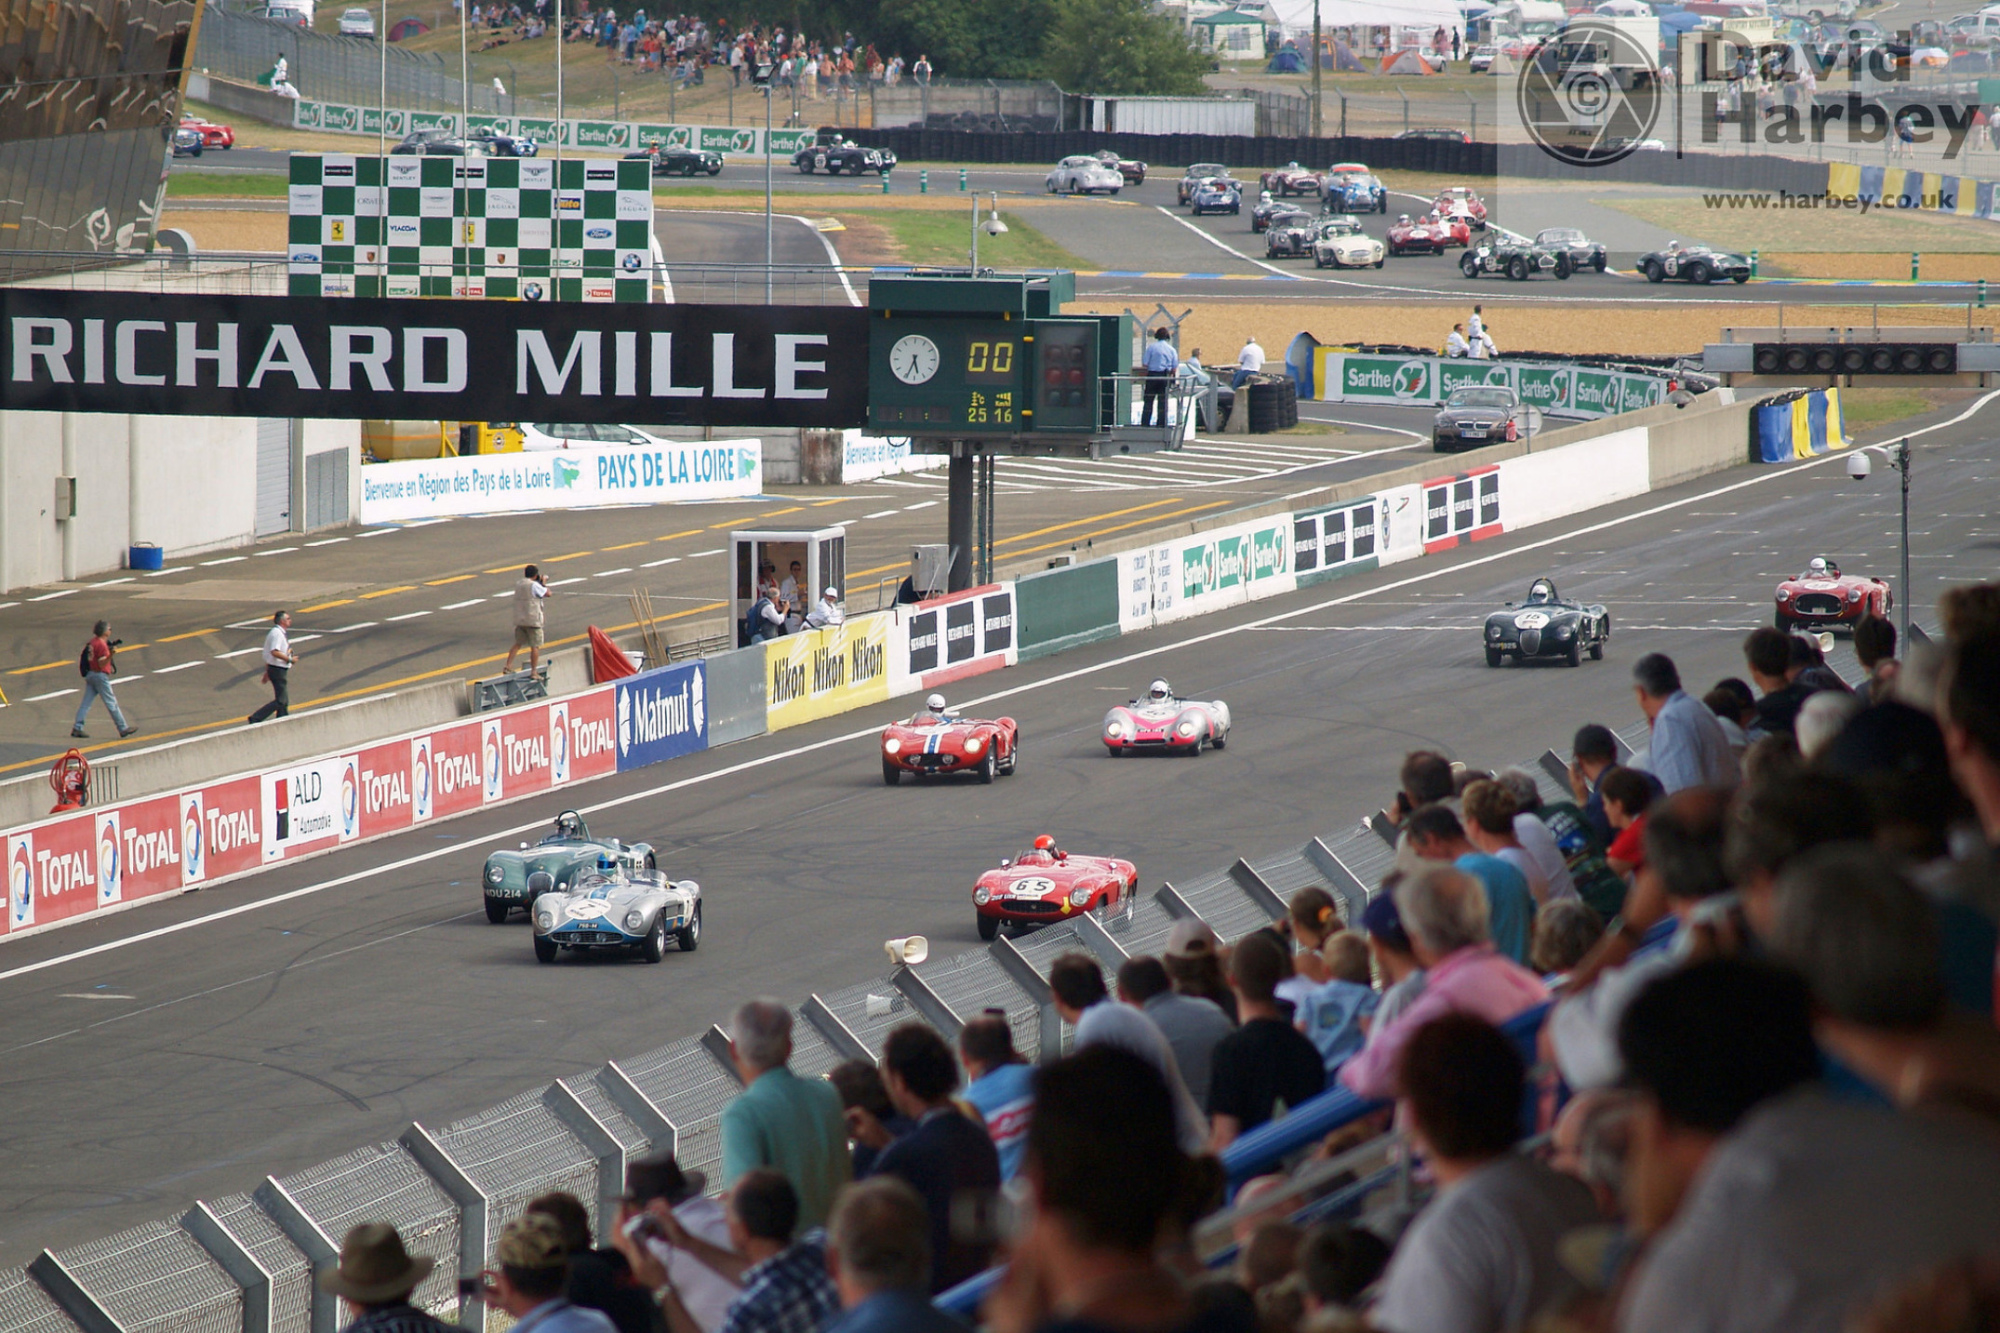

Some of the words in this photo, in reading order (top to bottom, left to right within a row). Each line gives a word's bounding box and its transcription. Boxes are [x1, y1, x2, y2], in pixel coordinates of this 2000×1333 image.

[521, 123, 547, 140] Sarthe
[579, 125, 606, 143] Sarthe
[640, 126, 667, 145] Sarthe
[702, 131, 731, 149] Sarthe
[390, 225, 417, 233] VIACOM
[12, 316, 468, 393] RICHARD
[516, 329, 829, 399] MILLE
[967, 342, 1013, 373] 00
[1348, 367, 1392, 388] Sarthe
[1521, 378, 1550, 399] Sarthe
[968, 408, 987, 423] 25
[994, 408, 1013, 423] 16
[365, 478, 404, 501] Bienvenue
[406, 480, 416, 497] en
[418, 473, 450, 501] Région
[453, 475, 470, 492] des
[472, 469, 495, 497] Pays
[498, 468, 511, 490] de
[514, 467, 523, 489] la
[525, 466, 551, 489] Loire
[598, 453, 637, 489] PAYS
[642, 452, 664, 486] DE
[668, 450, 689, 483] LA
[693, 448, 735, 482] LOIRE
[1220, 551, 1239, 578] Sarthe
[1255, 542, 1273, 570] Sarthe
[1184, 558, 1202, 588] Sarthe
[773, 660, 805, 704] Nikon
[814, 646, 844, 693] Nikon
[852, 636, 883, 683] Nikon
[634, 680, 689, 745] Matmut
[571, 716, 614, 759] TOTAL
[505, 734, 549, 777] TOTAL
[293, 771, 322, 807] ALD
[434, 751, 481, 794] TOTAL
[362, 769, 411, 814] TOTAL
[206, 807, 260, 853] TOTAL
[124, 827, 180, 875] TOTAL
[37, 849, 95, 897] TOTAL
[504, 889, 522, 899] 214
